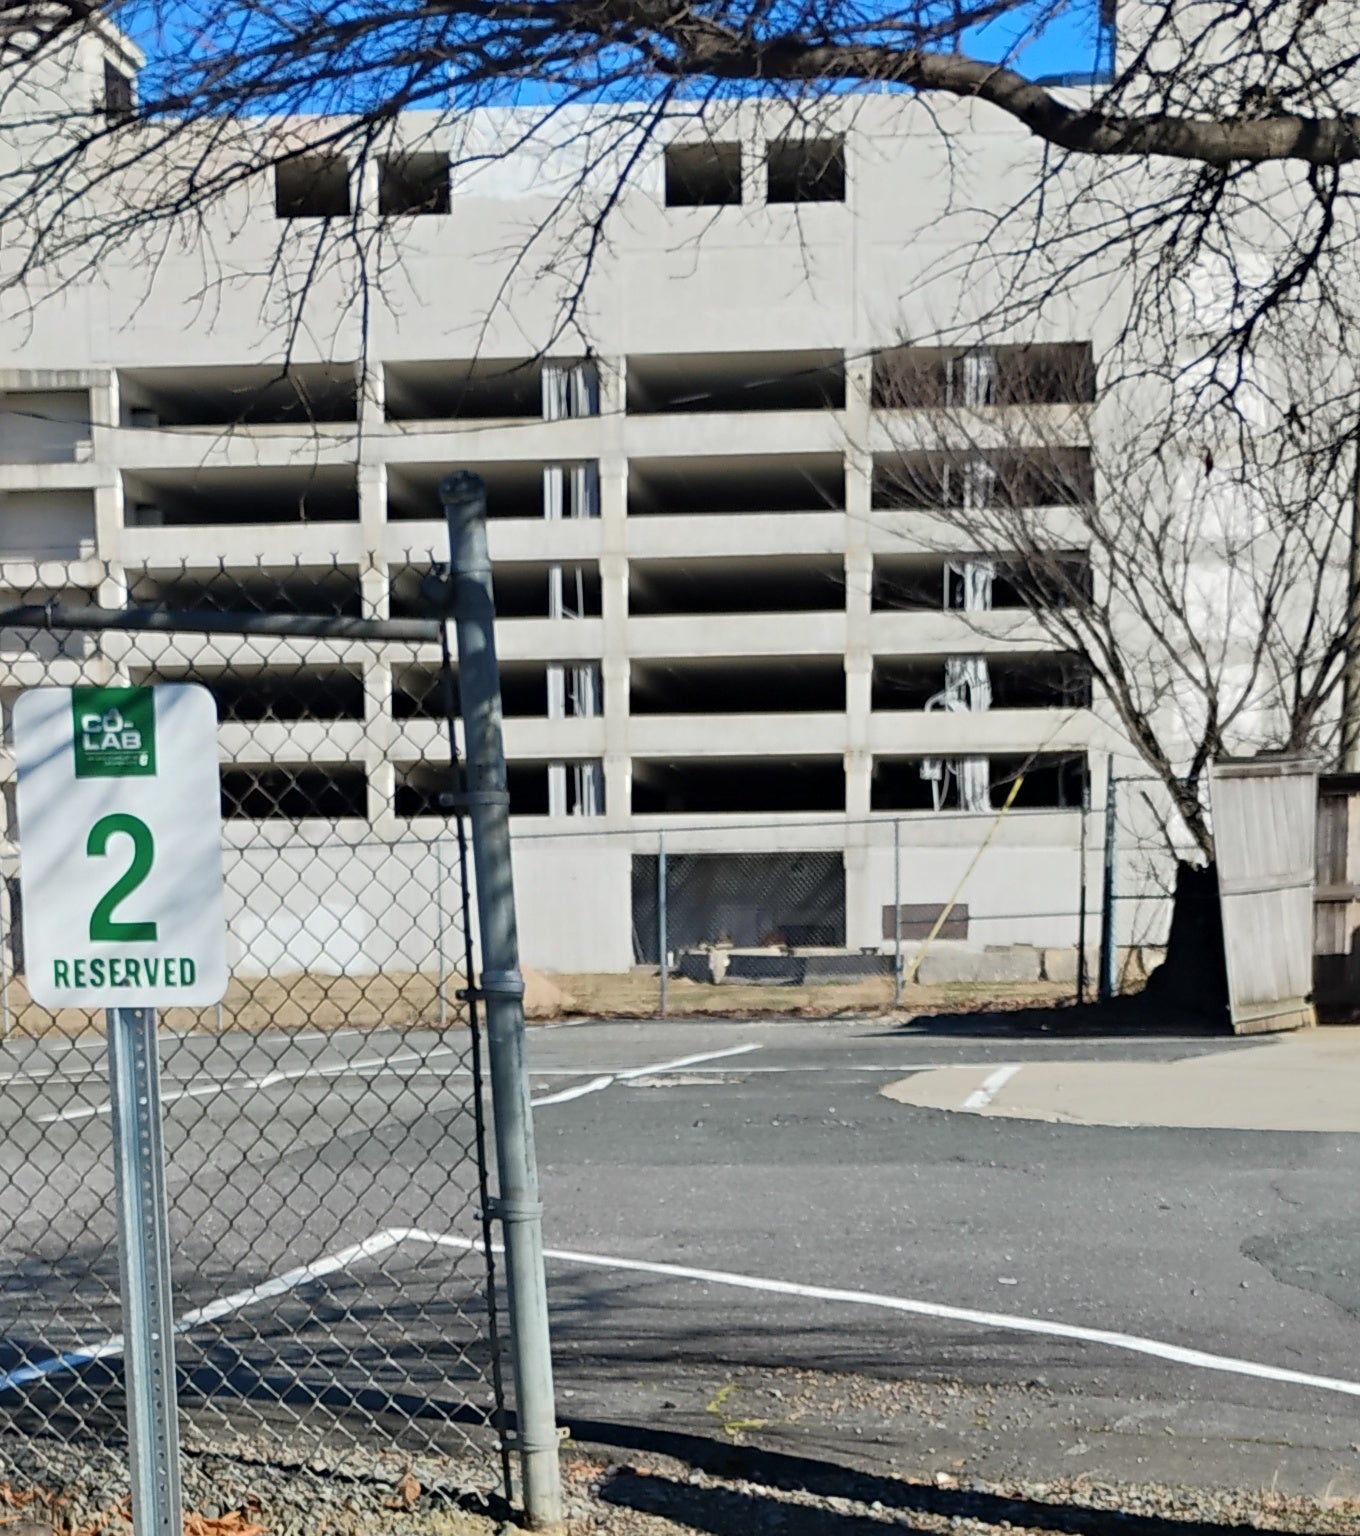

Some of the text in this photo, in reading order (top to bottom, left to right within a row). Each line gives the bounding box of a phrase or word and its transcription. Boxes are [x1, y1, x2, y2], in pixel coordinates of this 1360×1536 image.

[82, 730, 142, 751] LAB
[86, 812, 158, 942] 2
[53, 957, 197, 989] RESERVED
